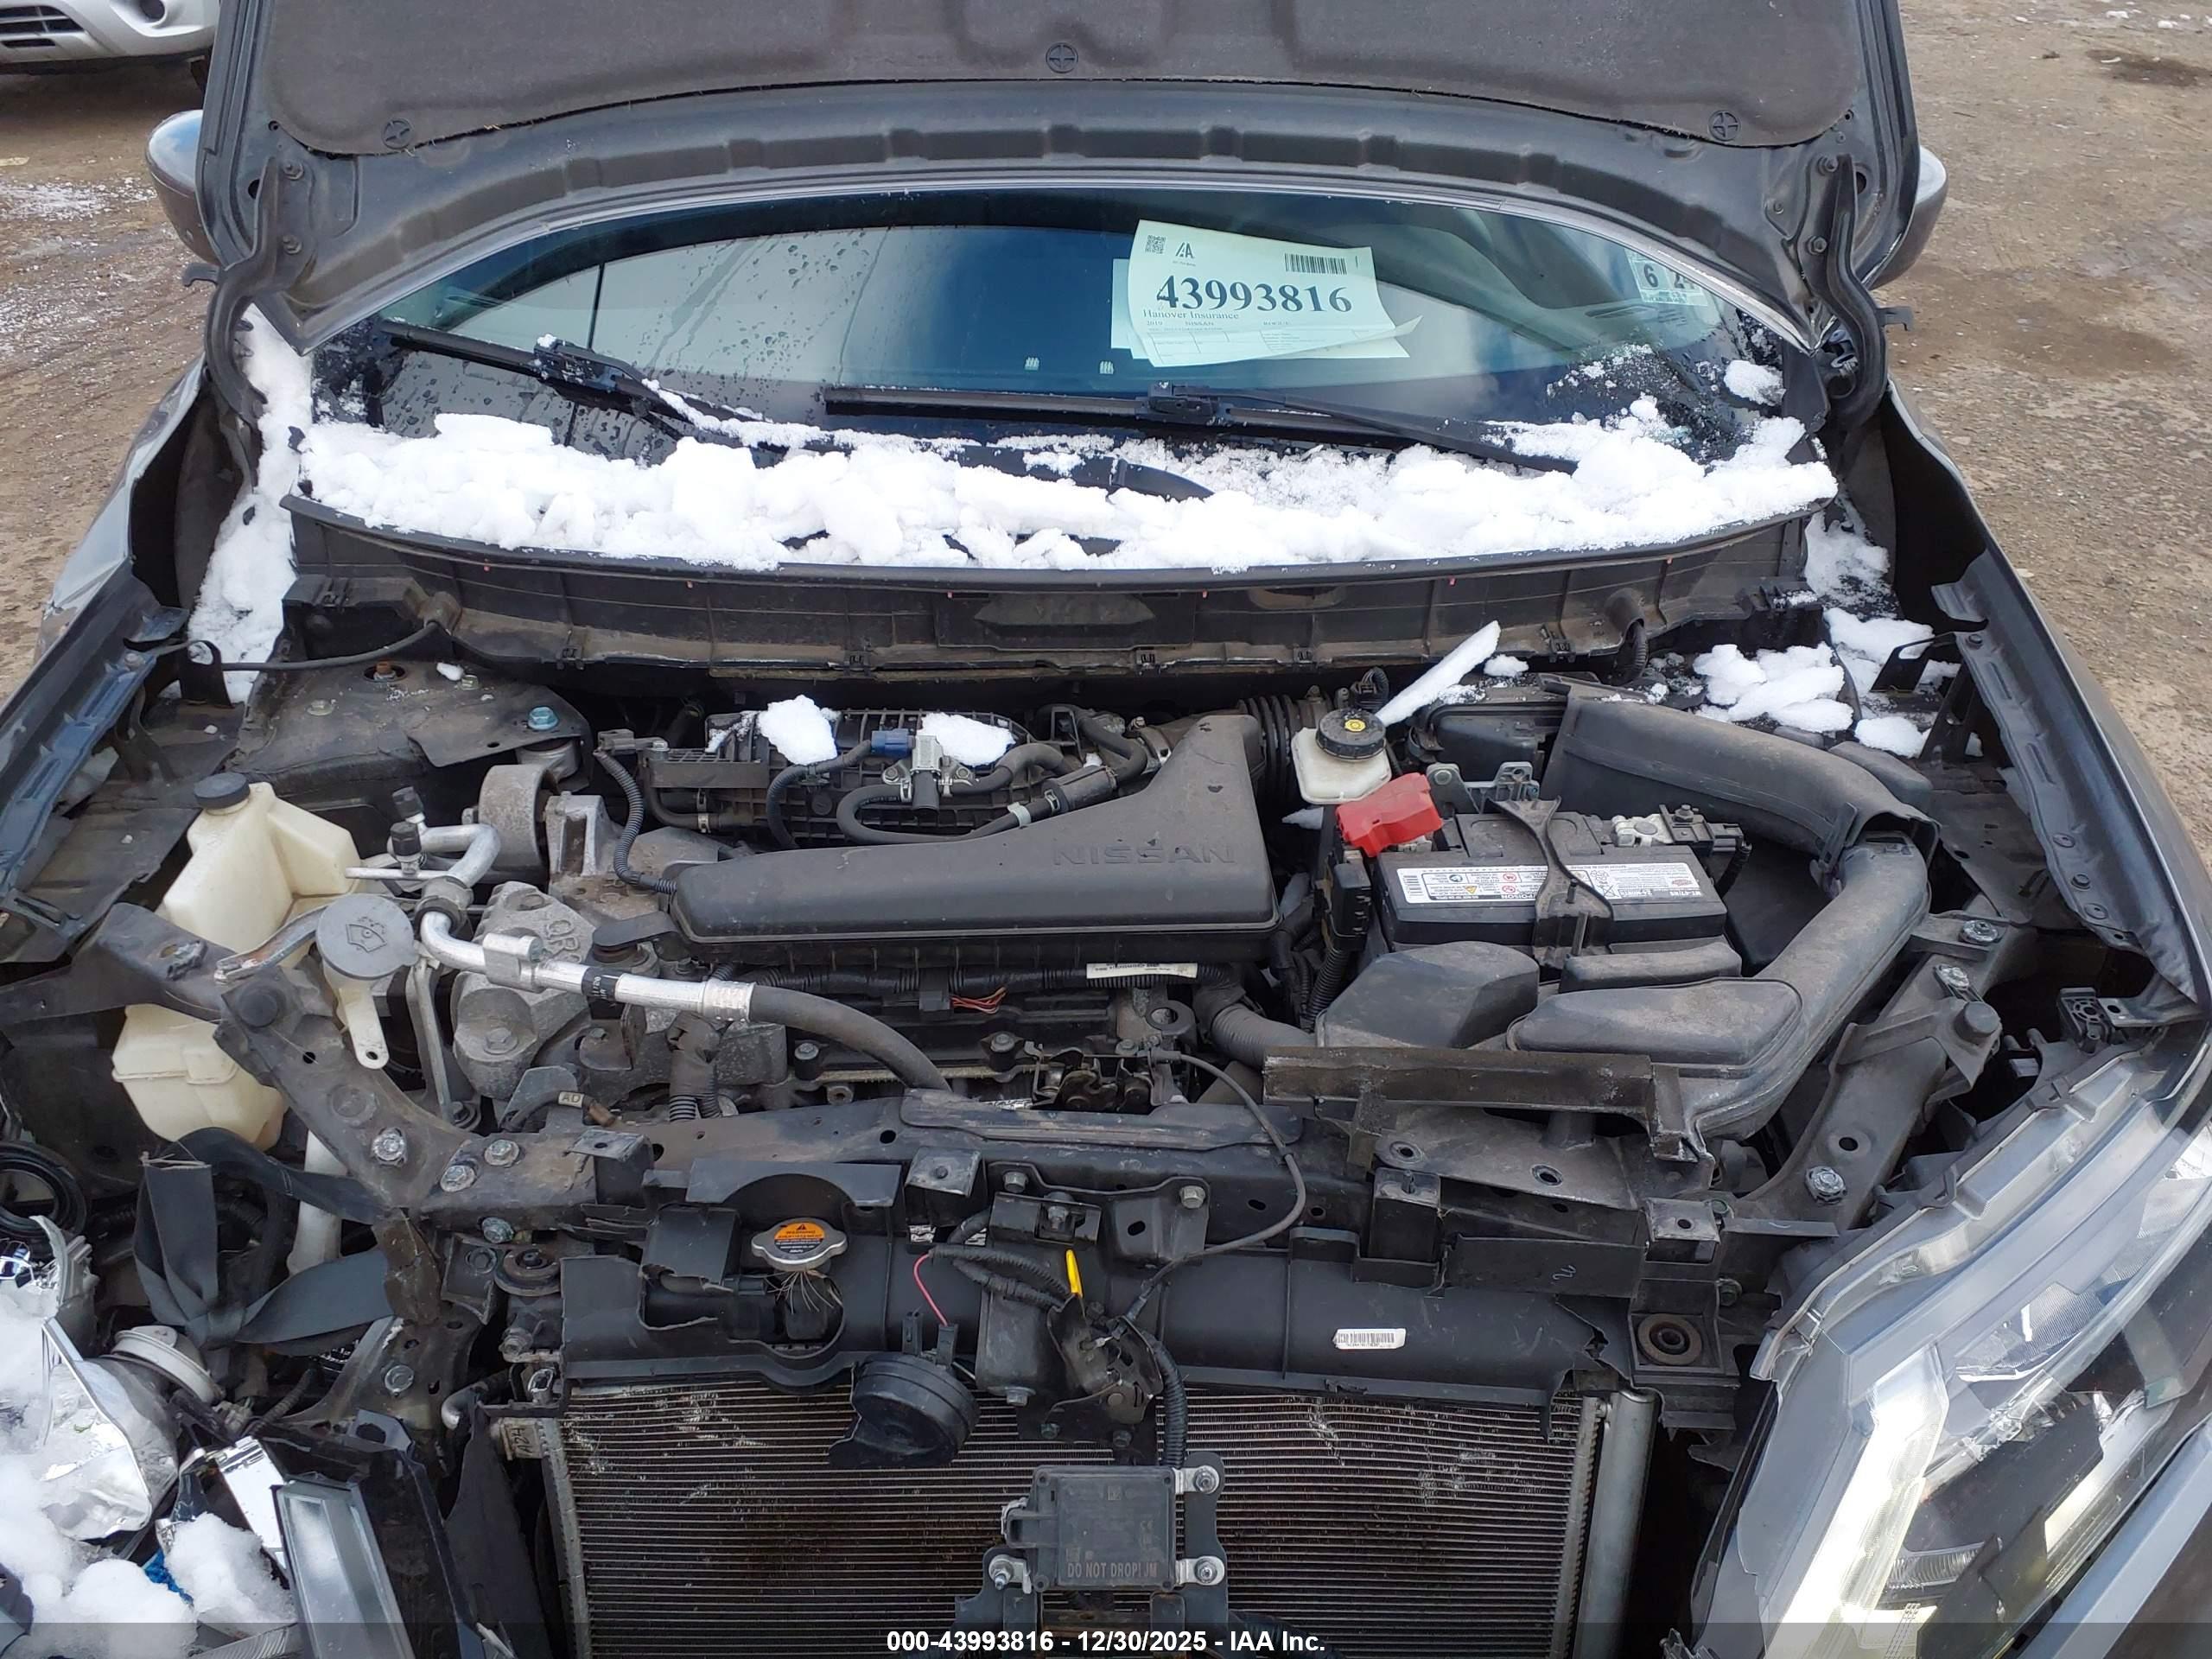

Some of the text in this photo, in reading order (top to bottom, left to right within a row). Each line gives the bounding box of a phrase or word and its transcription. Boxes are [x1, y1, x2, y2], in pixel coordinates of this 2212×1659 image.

[1643, 264, 1658, 288] 6
[1156, 275, 1352, 313] 43993816
[1143, 308, 1239, 321] Hanover Insurance
[1054, 843, 1236, 865] NISSAN
[1067, 1562, 1082, 1578] DO
[1085, 1562, 1107, 1578] NOT
